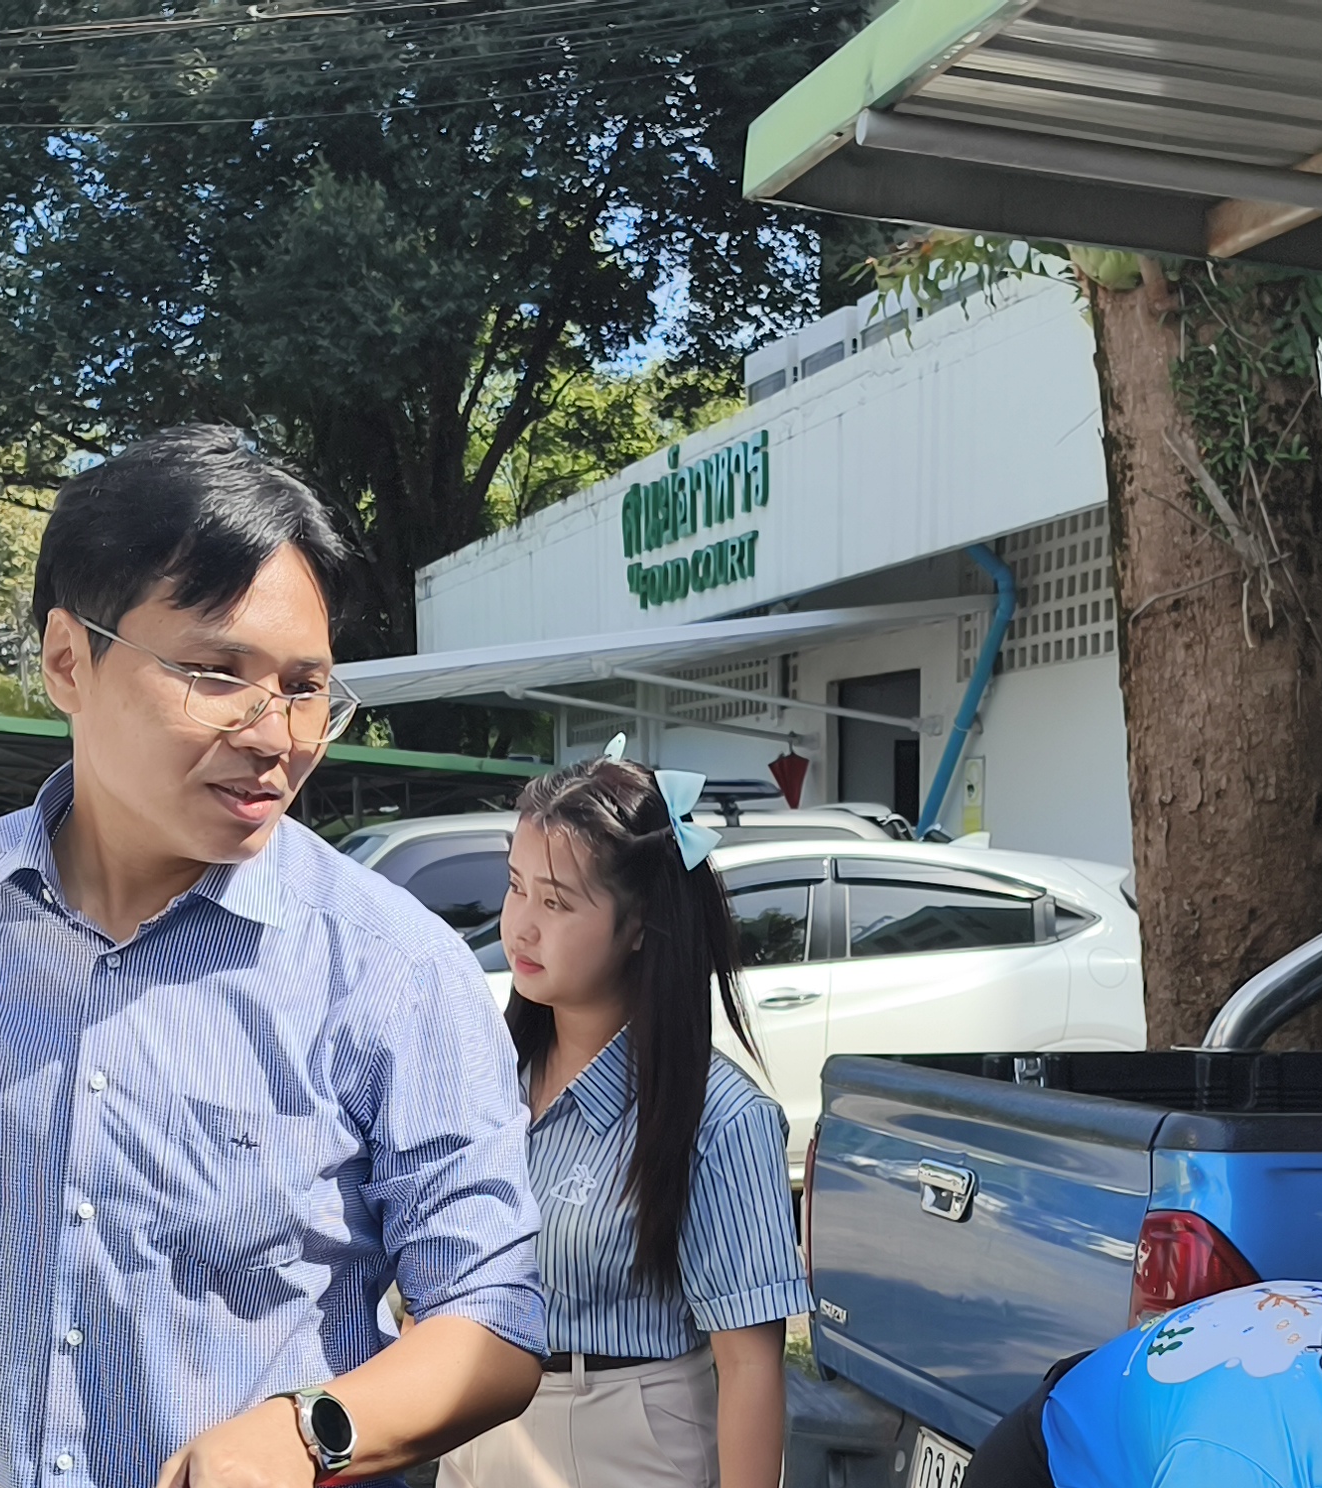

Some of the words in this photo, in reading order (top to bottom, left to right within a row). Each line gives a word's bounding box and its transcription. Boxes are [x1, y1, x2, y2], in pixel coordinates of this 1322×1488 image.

[621, 429, 770, 595] ศูนย์อาหาร
[639, 557, 690, 610] FOOD
[691, 529, 760, 593] COURT
